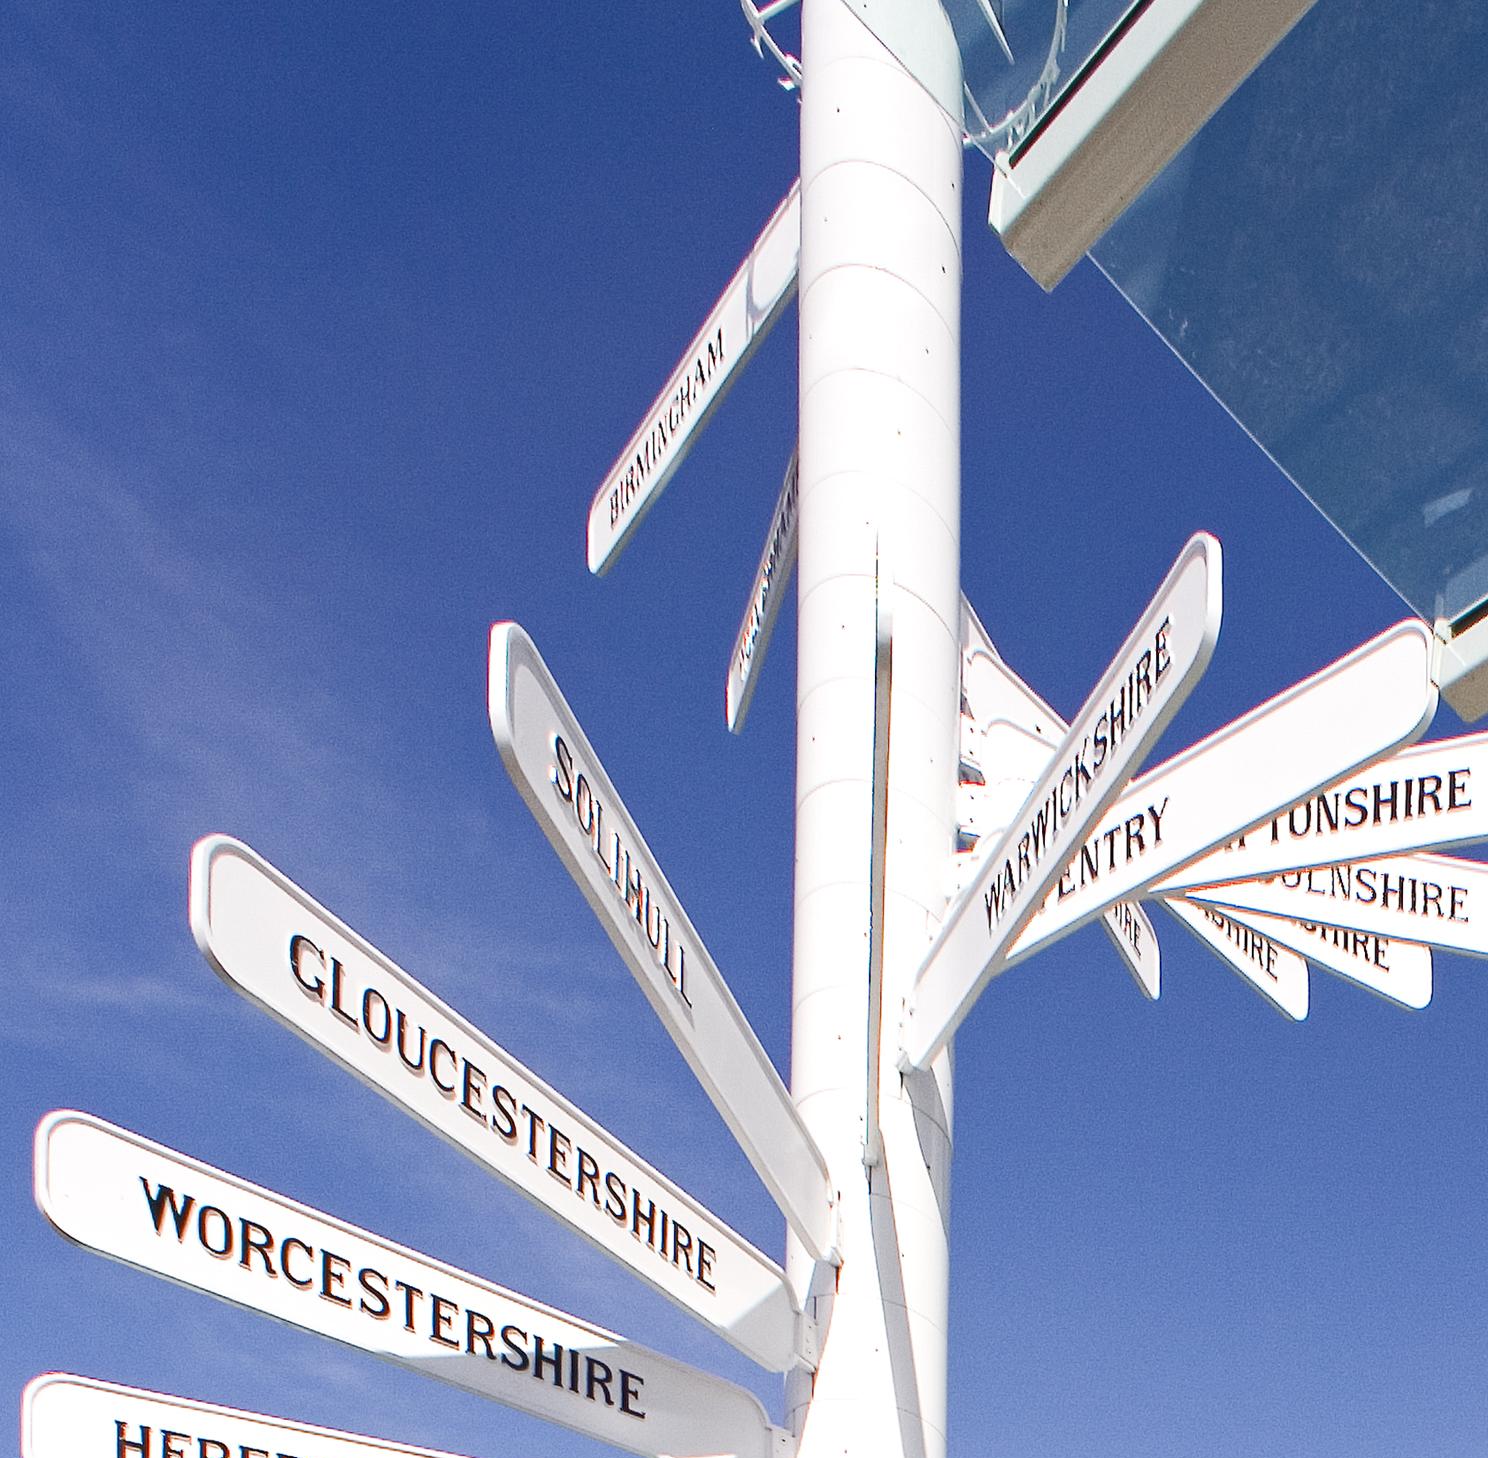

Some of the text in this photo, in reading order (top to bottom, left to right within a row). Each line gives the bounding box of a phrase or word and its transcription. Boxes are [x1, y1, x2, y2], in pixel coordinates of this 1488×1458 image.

[608, 326, 725, 530] BIRMINGHAM
[551, 732, 693, 1010] SOLIHULL
[985, 614, 1173, 936] WARWICKSHIRE
[1040, 797, 1170, 910] ENTRY
[289, 934, 717, 1292] GLOUCESTERSHIRE
[142, 1176, 647, 1421] WORCESTERSHIRE
